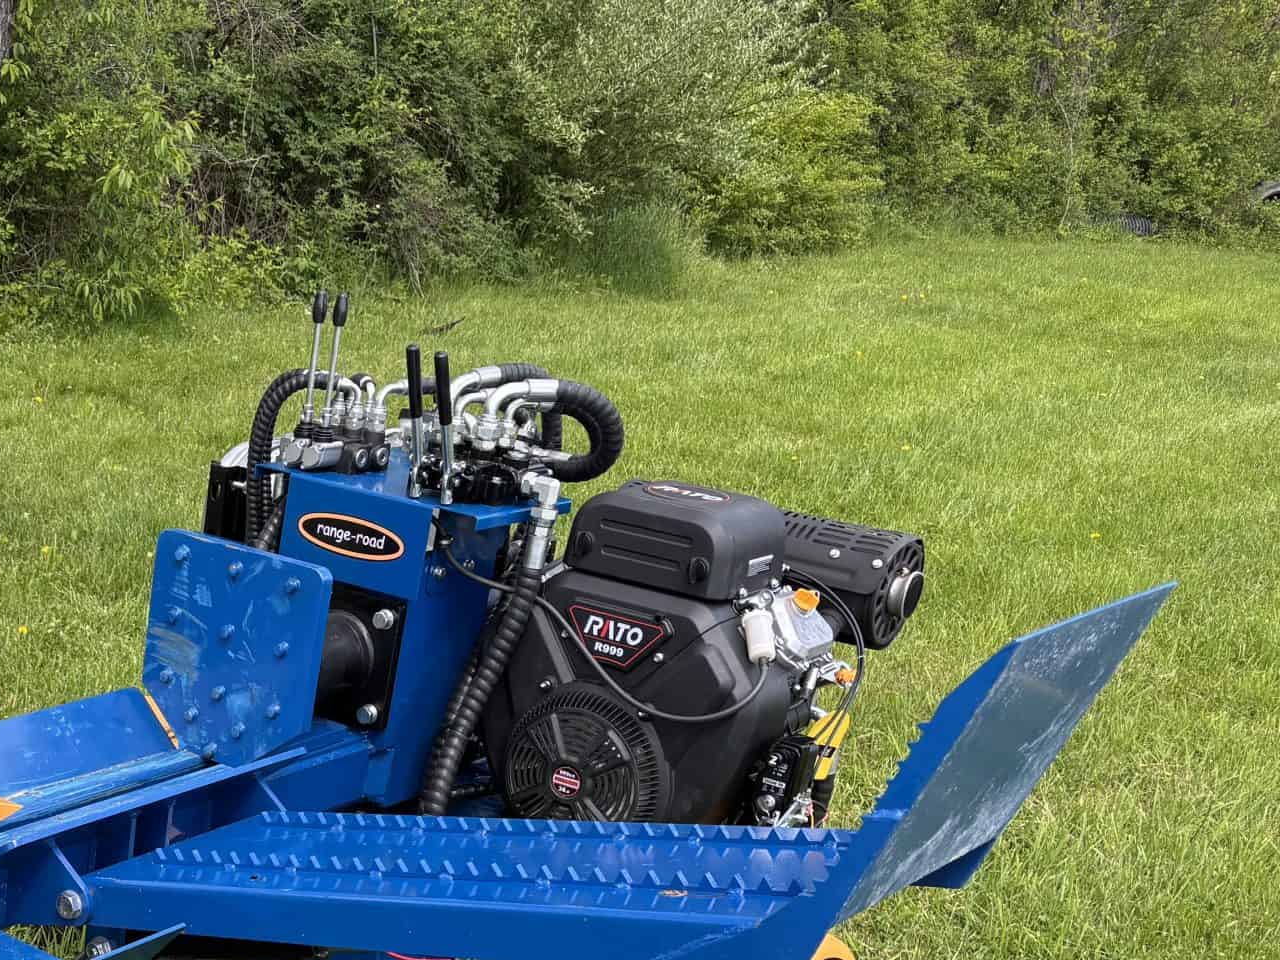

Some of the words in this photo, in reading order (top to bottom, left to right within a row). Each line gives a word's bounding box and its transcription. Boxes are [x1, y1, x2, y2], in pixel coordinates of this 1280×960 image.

[317, 523, 386, 549] range-road
[583, 615, 644, 646] RATO
[594, 641, 624, 657] R999
